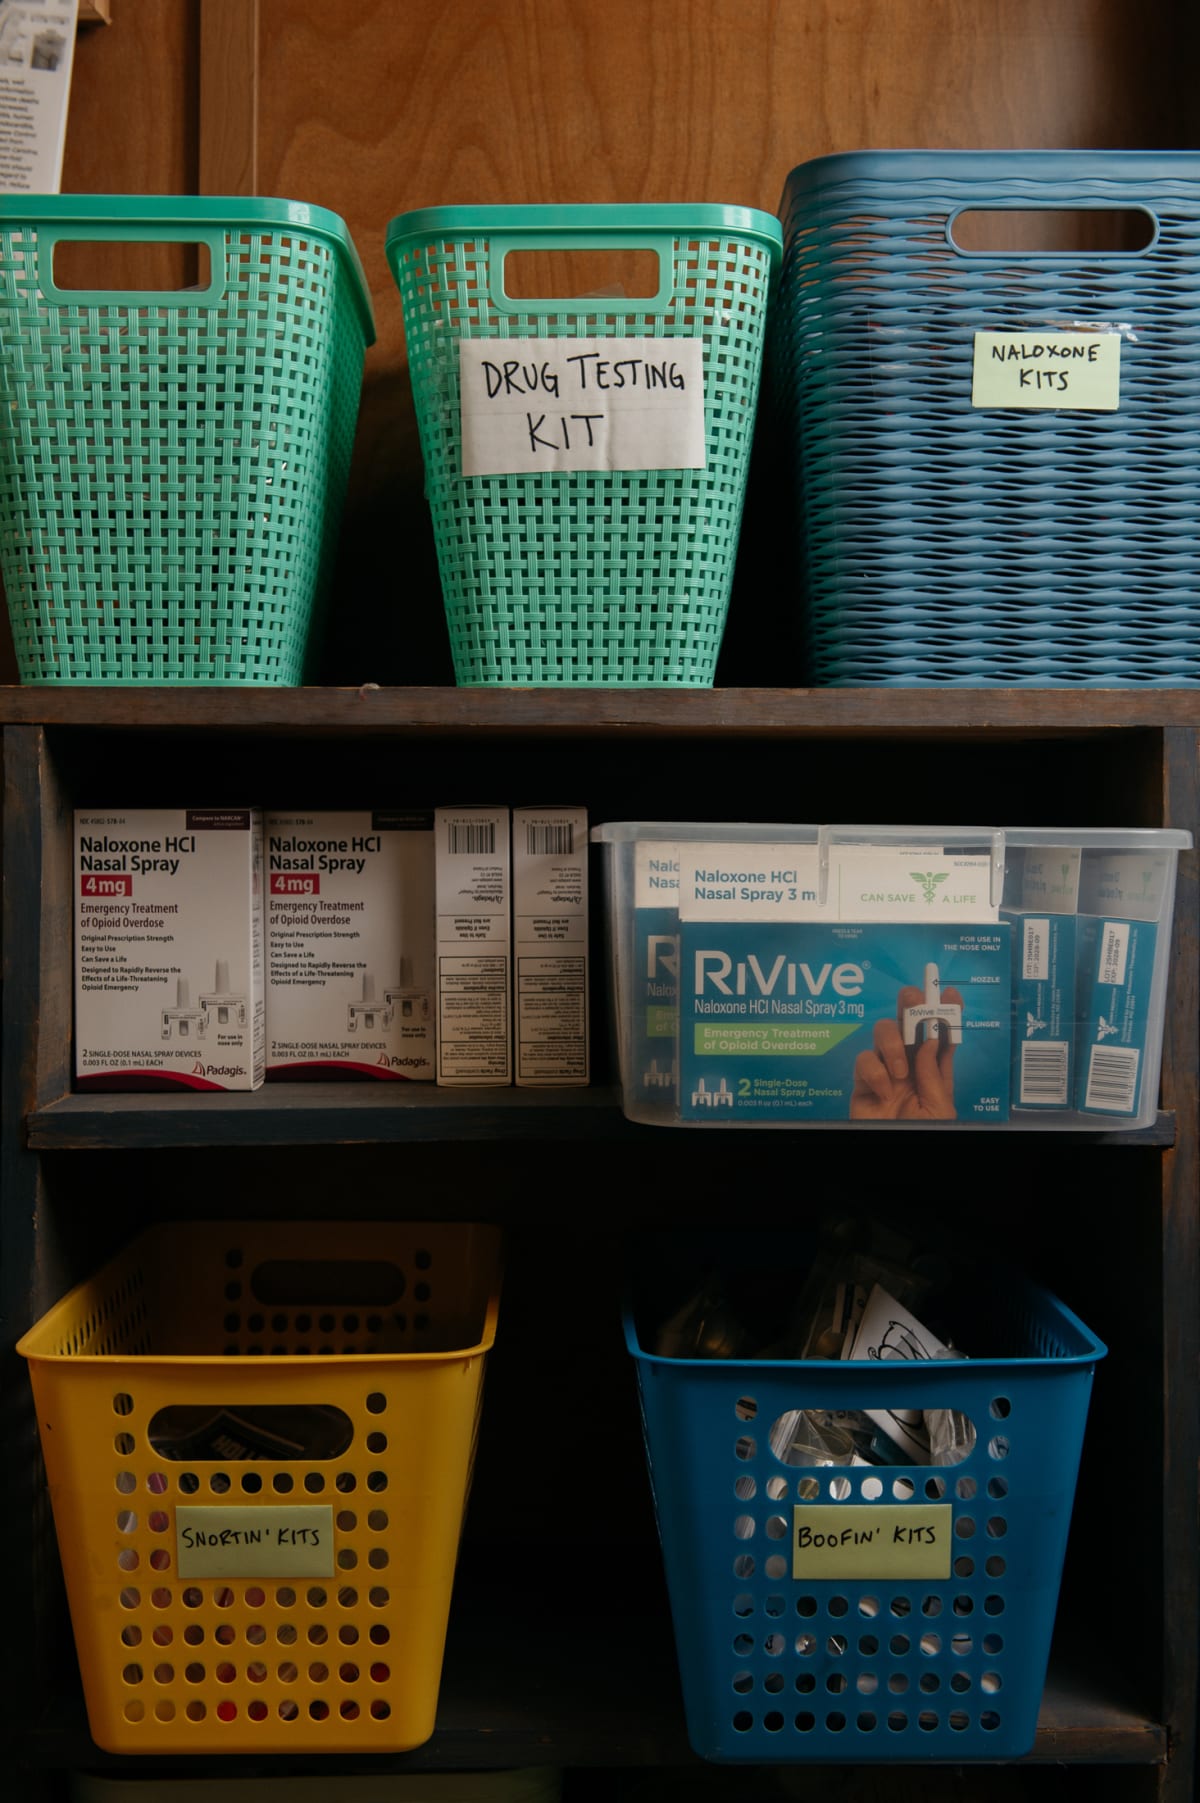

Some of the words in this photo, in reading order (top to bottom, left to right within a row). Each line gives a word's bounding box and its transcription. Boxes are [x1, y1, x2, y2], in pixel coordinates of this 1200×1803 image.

[992, 344, 1101, 362] NALOXONE
[482, 361, 560, 399] DRUG
[567, 353, 685, 390] TESTING
[1020, 368, 1069, 391] KITS
[527, 412, 604, 452] KIT
[80, 836, 161, 852] Naloxone
[166, 836, 195, 852] HCl
[270, 836, 348, 852] Naloxone
[352, 836, 380, 852] HCl
[80, 855, 126, 870] Nasal
[131, 855, 179, 874] Spray
[270, 855, 314, 870] Nasal
[319, 855, 365, 874] Spray
[695, 870, 766, 883] Naloxone
[771, 870, 797, 883] HCl
[86, 878, 96, 892] 4
[98, 880, 126, 895] mg
[275, 876, 286, 890] 4
[288, 879, 313, 894] mg
[695, 888, 735, 900] Nasal
[741, 888, 783, 902] Spray
[788, 888, 796, 900] 3
[802, 891, 816, 900] m
[861, 894, 884, 902] CAN
[888, 894, 916, 902] SAVE
[954, 895, 976, 903] LIFE
[81, 903, 129, 916] Emergency
[132, 903, 178, 913] Treatment
[270, 901, 317, 913] Emergency
[319, 901, 364, 911] Treatment
[81, 917, 90, 928] of
[92, 917, 120, 930] Opioid
[123, 917, 164, 928] Overdose
[270, 914, 279, 924] of
[281, 914, 308, 926] Opioid
[311, 914, 351, 924] Overdose
[81, 935, 106, 943] Original
[108, 935, 145, 943] Prescription
[147, 935, 174, 943] Strength
[116, 976, 168, 984] Life-Threatening
[695, 1000, 746, 1015] Naloxone
[750, 1000, 768, 1015] HCl
[772, 1000, 802, 1015] Nasal
[806, 1000, 837, 1017] Spray
[838, 1000, 845, 1015] 3
[847, 1003, 864, 1017] mg
[704, 1028, 768, 1039] Emergency
[772, 1028, 830, 1038] Treatment
[83, 1049, 87, 1057] 2
[704, 1040, 716, 1050] of
[720, 1040, 758, 1051] Opioid
[762, 1040, 816, 1050] Overdose
[738, 1078, 751, 1096] 2
[754, 1079, 808, 1088] Single-Dose
[780, 1089, 805, 1098] Spray
[182, 1528, 269, 1548] SNORTIN'
[278, 1528, 319, 1546] KITS
[799, 1526, 880, 1548] BOOFIN'
[894, 1526, 935, 1544] KITS
